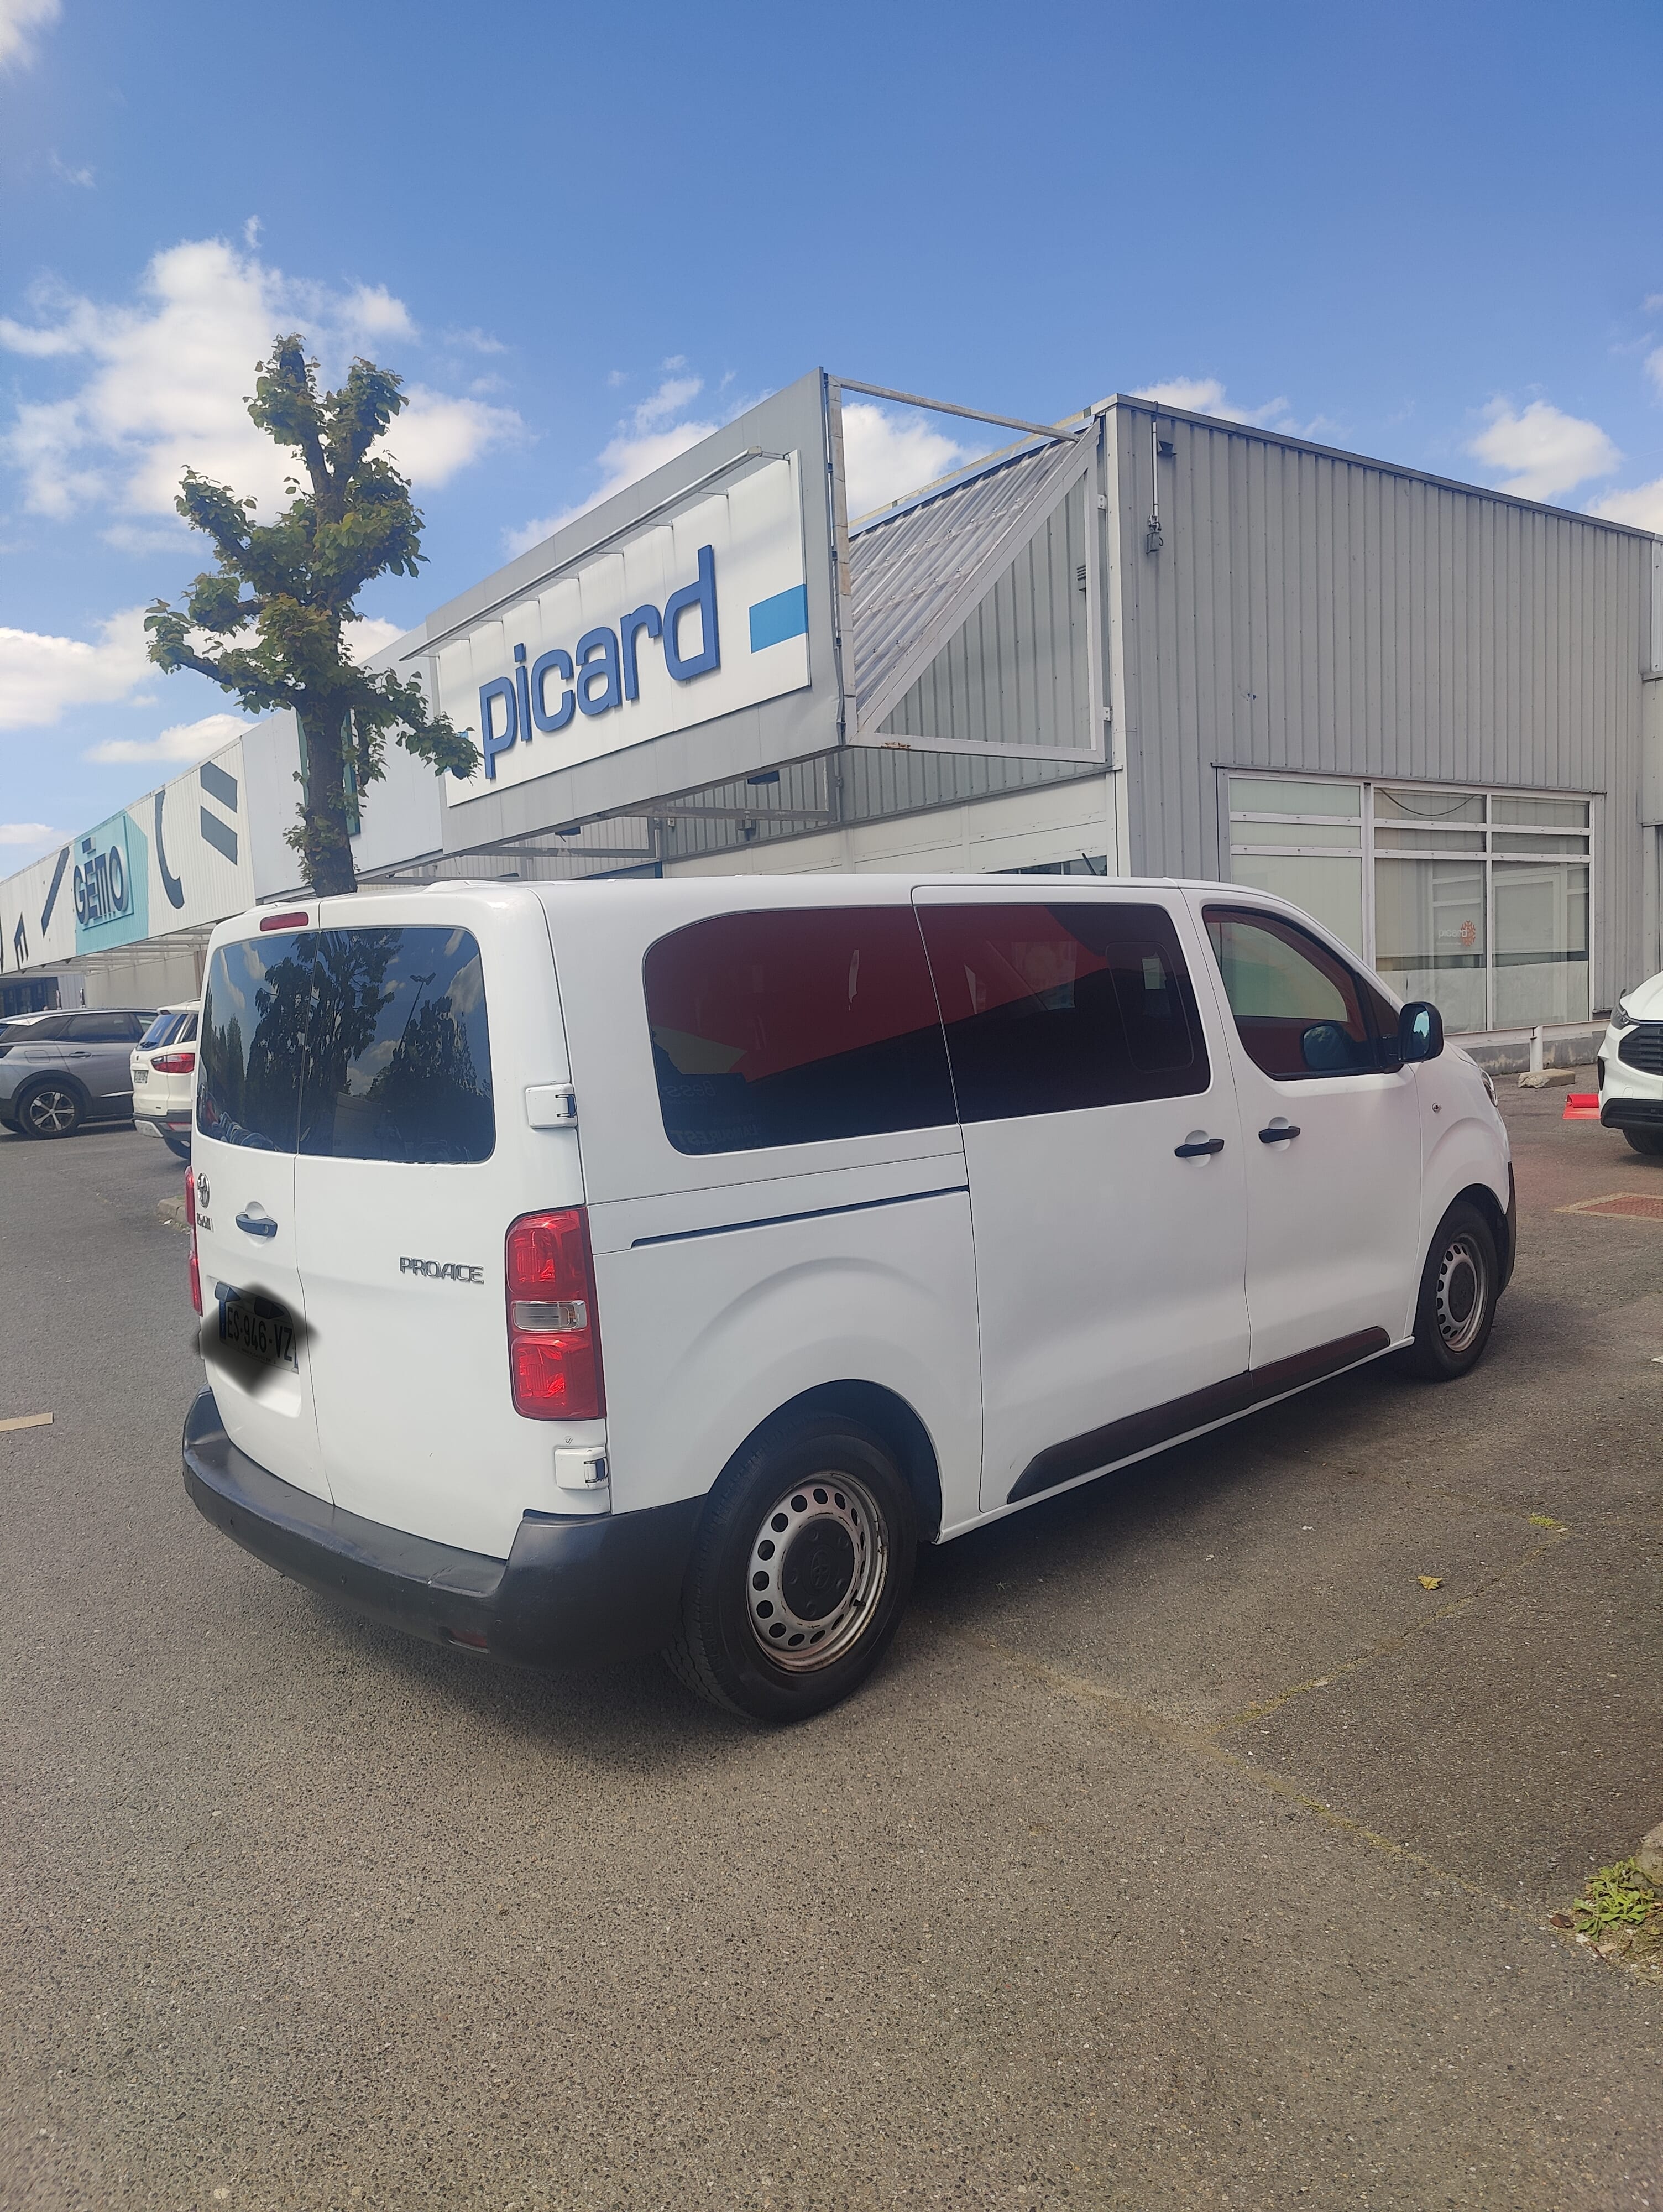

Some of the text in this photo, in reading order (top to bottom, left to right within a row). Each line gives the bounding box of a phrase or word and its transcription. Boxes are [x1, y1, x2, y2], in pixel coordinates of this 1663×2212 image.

[479, 544, 721, 780] picard
[1438, 927, 1468, 939] picard
[400, 1256, 484, 1284] PROACE
